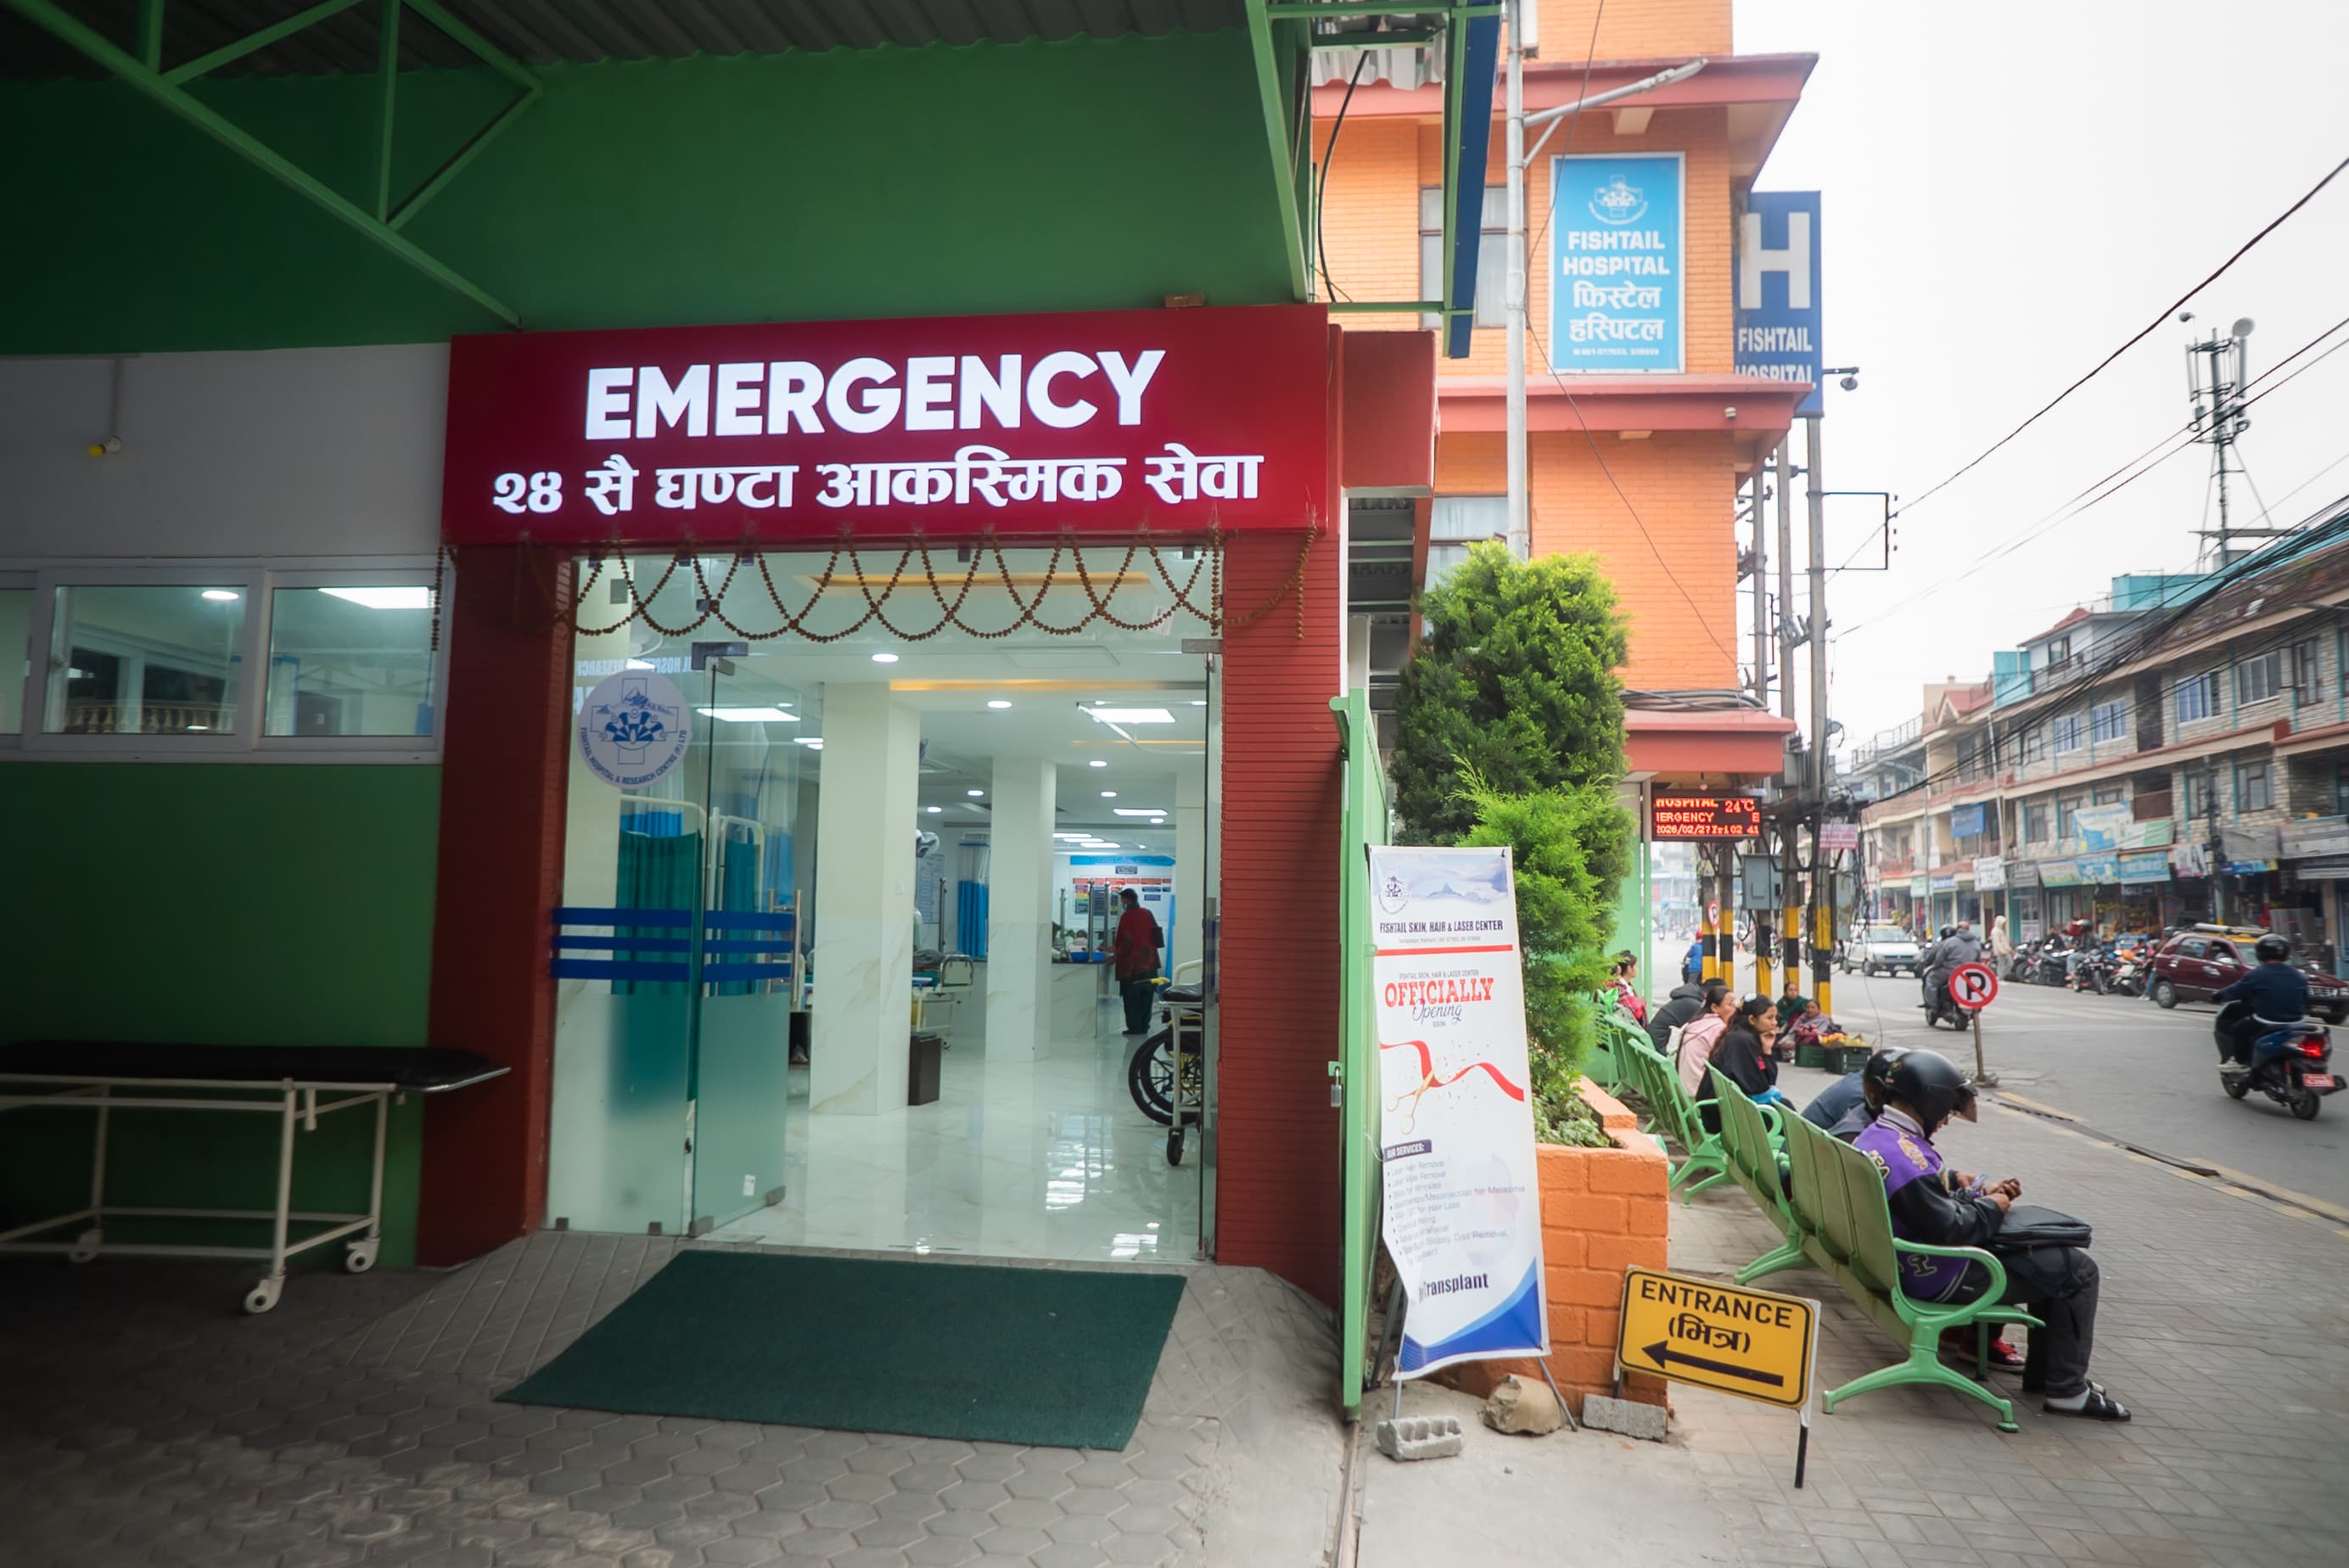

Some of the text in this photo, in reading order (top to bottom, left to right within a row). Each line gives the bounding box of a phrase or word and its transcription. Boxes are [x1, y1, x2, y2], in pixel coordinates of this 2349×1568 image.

[1568, 230, 1665, 250] FISHTAIL
[1562, 256, 1670, 276] HOSPITAL
[1740, 212, 1811, 309] H
[1737, 327, 1813, 352] FISHTAIL
[585, 349, 1167, 440] EMERGENCY
[492, 442, 1264, 516] २४ सै घण्टा आकस्मिक सेवा
[1656, 812, 1714, 822] ERGENCY
[1380, 920, 1503, 933] FISHTAIL SKIN, HAIR & LASER CENTER
[1384, 977, 1494, 1008] OFFICIALLY
[1412, 998, 1462, 1025] Opening
[1641, 1279, 1792, 1329] ENTRANCE
